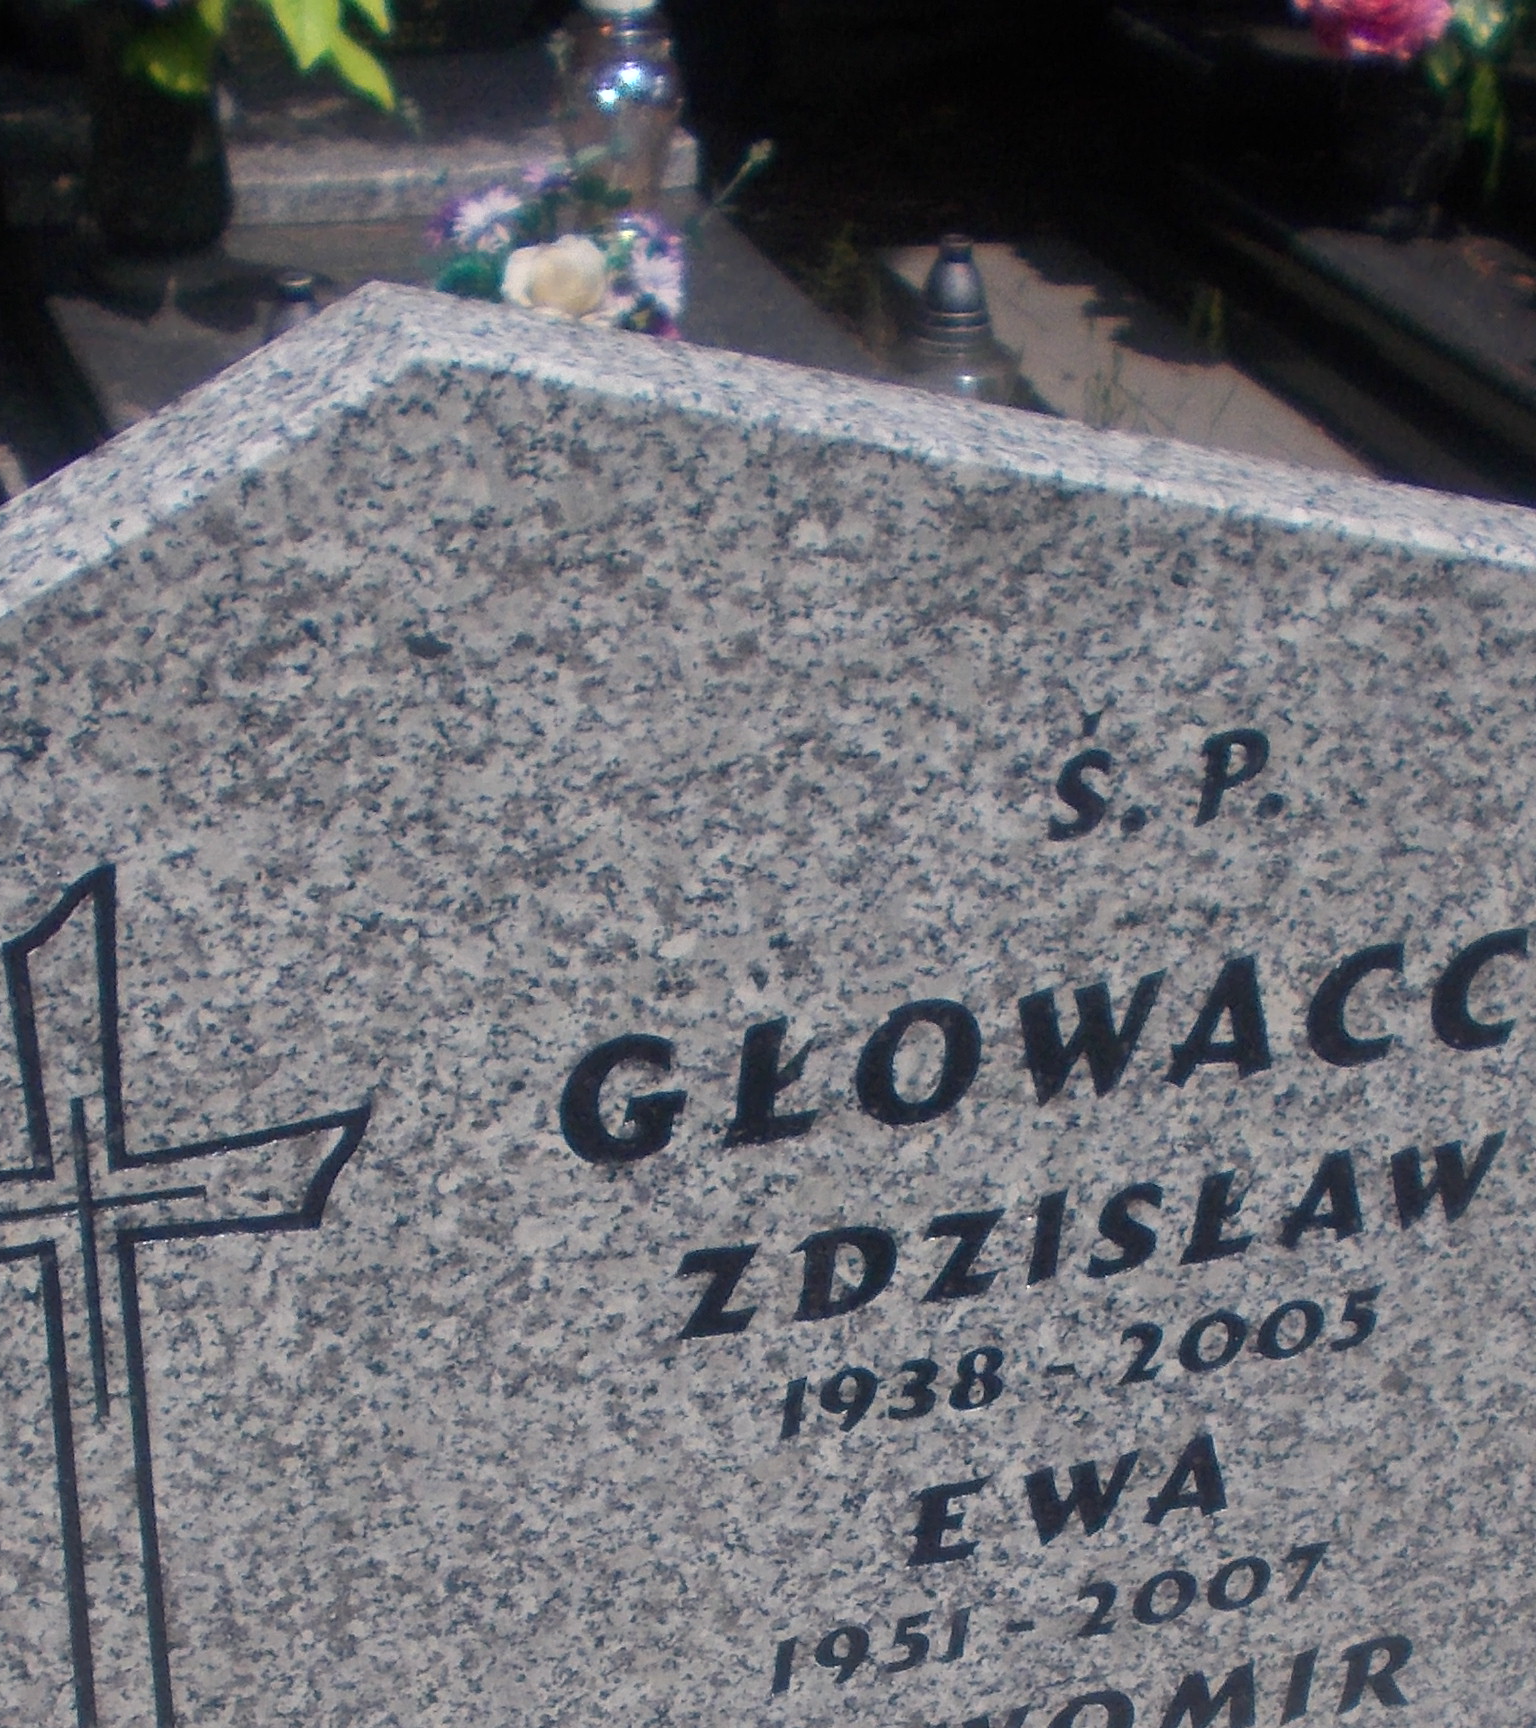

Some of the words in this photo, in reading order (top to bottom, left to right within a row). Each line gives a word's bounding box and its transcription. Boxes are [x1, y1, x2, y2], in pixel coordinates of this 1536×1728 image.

[1192, 725, 1287, 829] P.
[674, 1130, 1507, 1342] ZDZISŁAW
[778, 1344, 1004, 1440] 1938
[1116, 1286, 1384, 1386] 2005
[907, 1432, 1228, 1567] EWA
[768, 1606, 968, 1696] 1951
[1075, 1541, 1331, 1640] 2007
